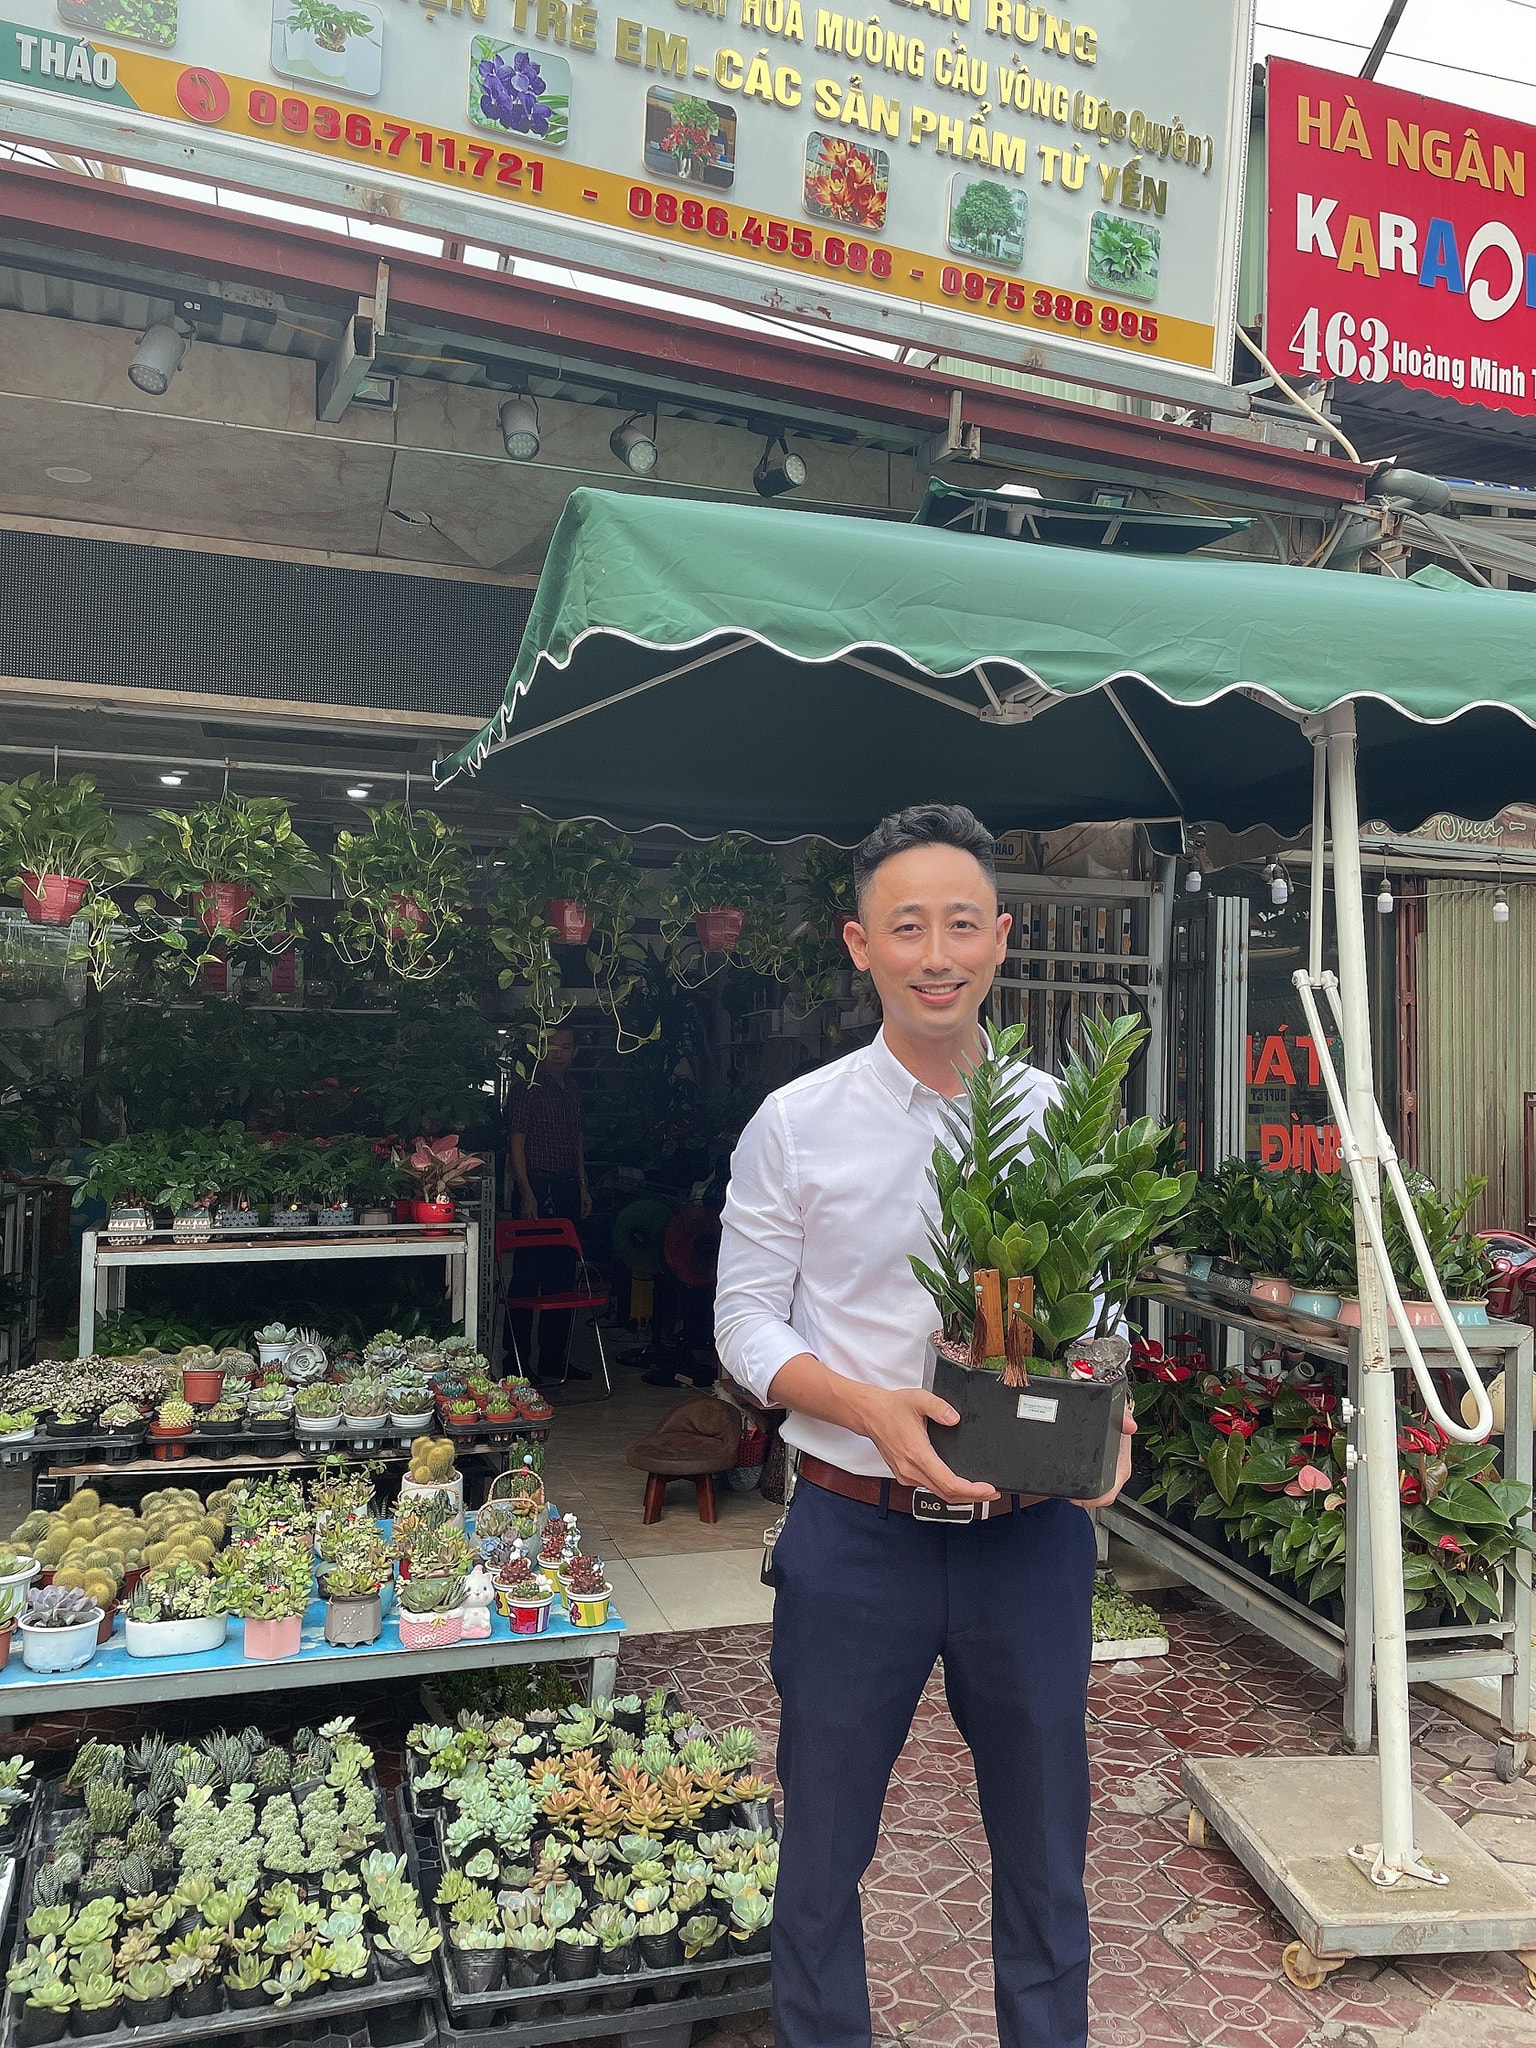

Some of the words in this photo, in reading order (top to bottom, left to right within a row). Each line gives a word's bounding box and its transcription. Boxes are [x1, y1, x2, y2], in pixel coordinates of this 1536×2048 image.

[815, 8, 926, 81] MUÔNG
[934, 30, 989, 98] CẦU
[998, 52, 1070, 125] VỒNG
[248, 89, 545, 195] 0936.711.721
[627, 193, 893, 279] 0886.455.688
[813, 72, 900, 141] SẢN
[908, 100, 1027, 176] PHẨM
[1039, 141, 1091, 191] TỪ
[1098, 154, 1168, 216] YẾN
[1297, 94, 1373, 161] HÀ
[1386, 117, 1525, 198] NGÂN
[1288, 306, 1390, 384] 463
[1391, 339, 1464, 390] Hoàng
[1470, 356, 1525, 398] Minh
[920, 1500, 941, 1511] D&G
